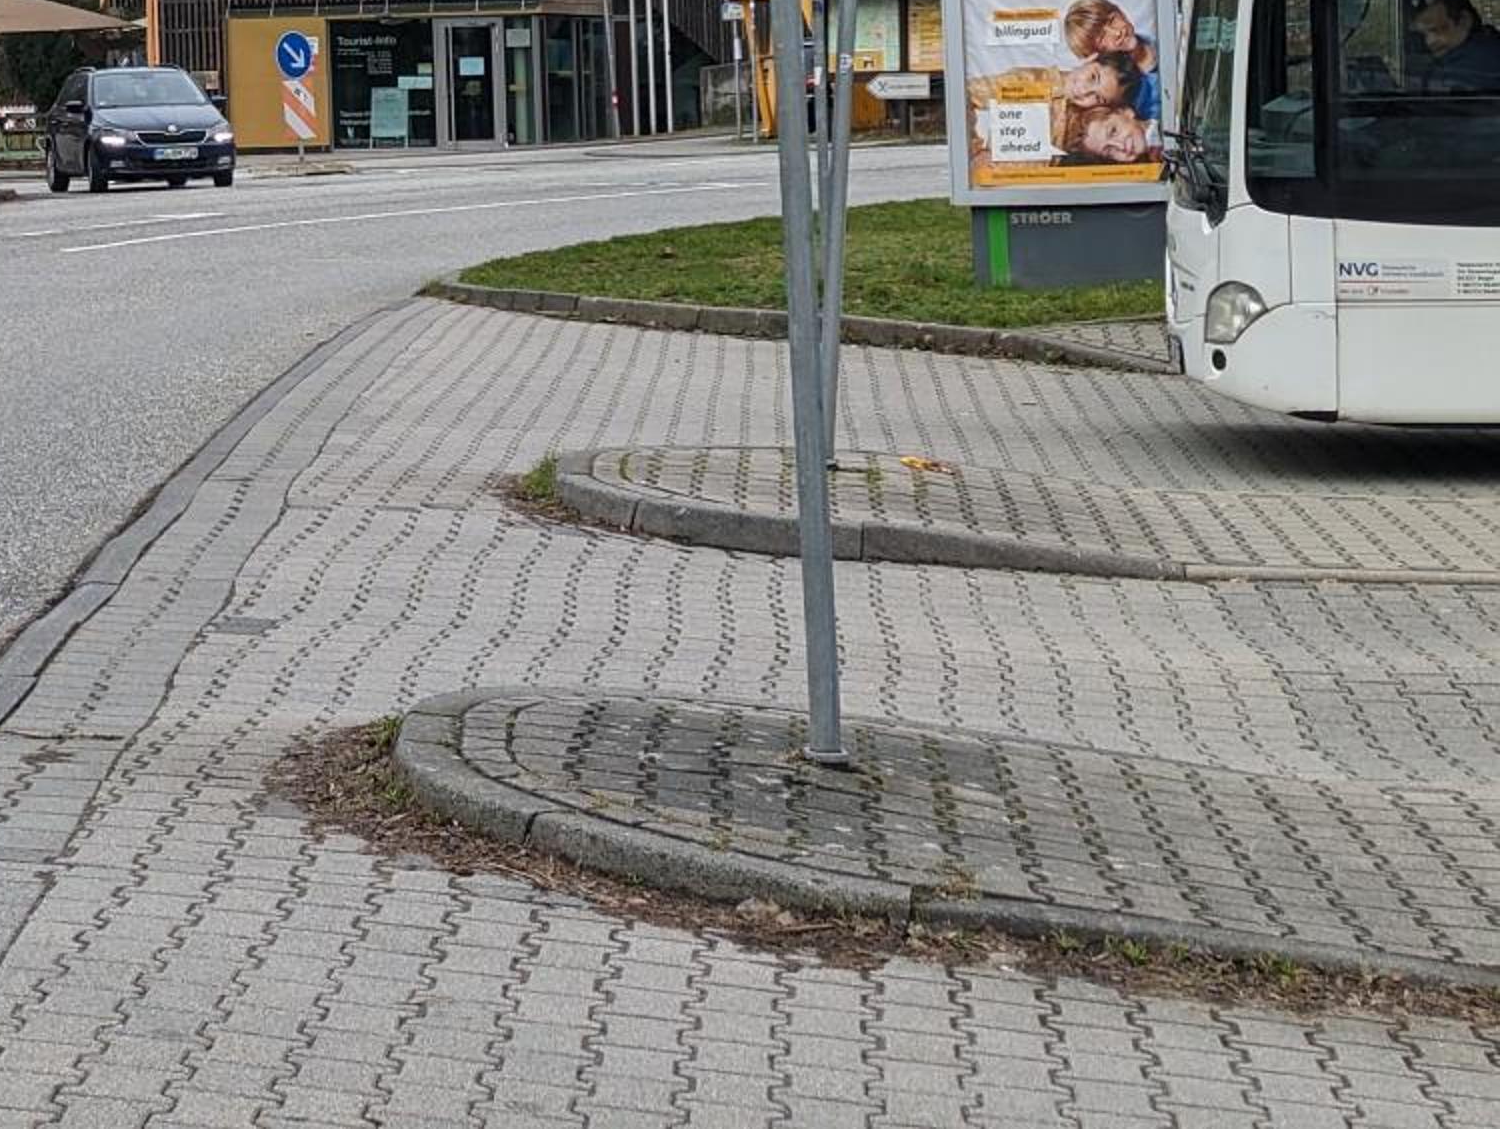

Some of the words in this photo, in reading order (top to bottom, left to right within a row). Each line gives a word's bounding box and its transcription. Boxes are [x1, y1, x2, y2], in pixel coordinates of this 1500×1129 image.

[995, 25, 1053, 40] bilingual
[998, 110, 1023, 121] one
[999, 126, 1027, 138] step
[1000, 142, 1041, 153] ahead
[1338, 262, 1379, 277] NVG
